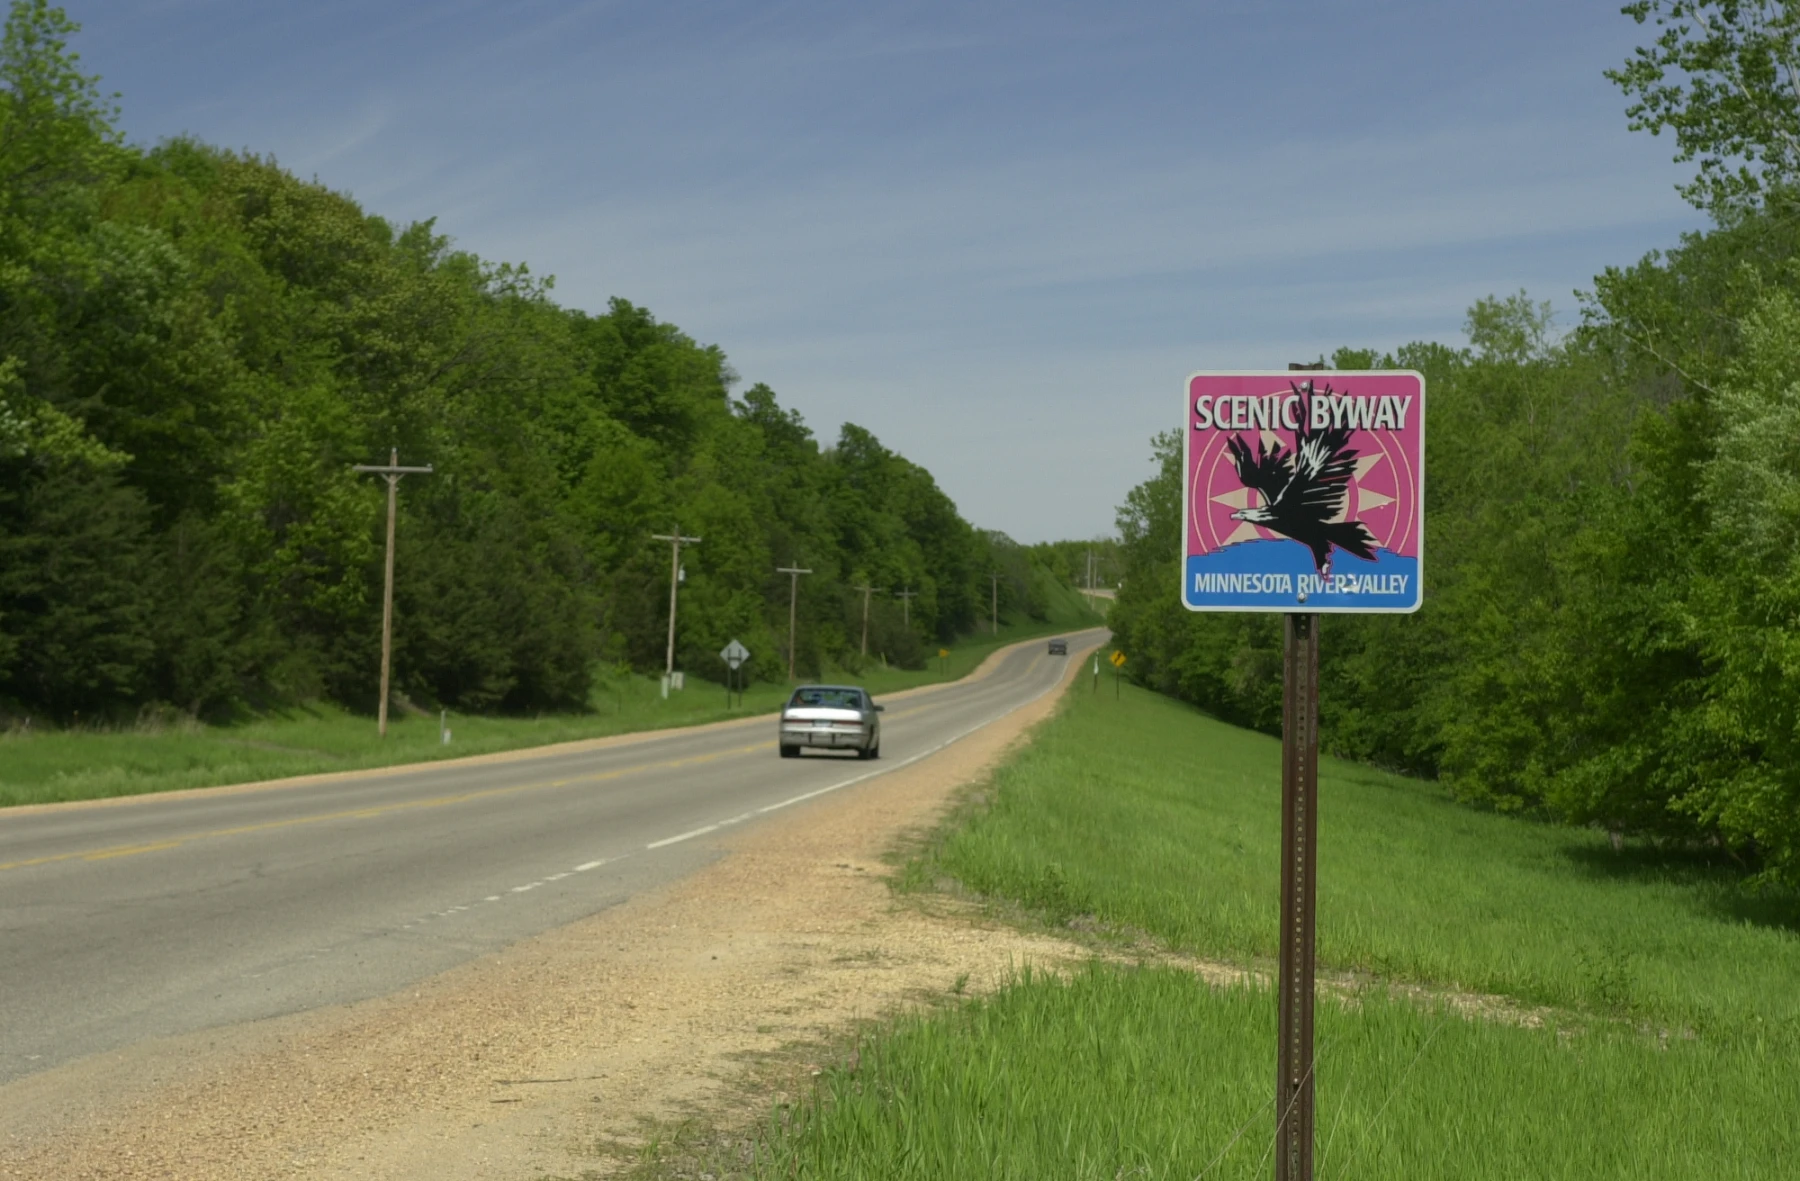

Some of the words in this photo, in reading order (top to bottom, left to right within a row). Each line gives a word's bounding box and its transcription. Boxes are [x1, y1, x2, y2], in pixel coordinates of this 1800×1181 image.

[1195, 395, 1299, 430] SCENIC
[1311, 395, 1412, 430] BYWAY
[1194, 573, 1292, 594] MINNESOTA
[1297, 574, 1347, 594] RIVER
[1354, 574, 1409, 594] VALLEY
